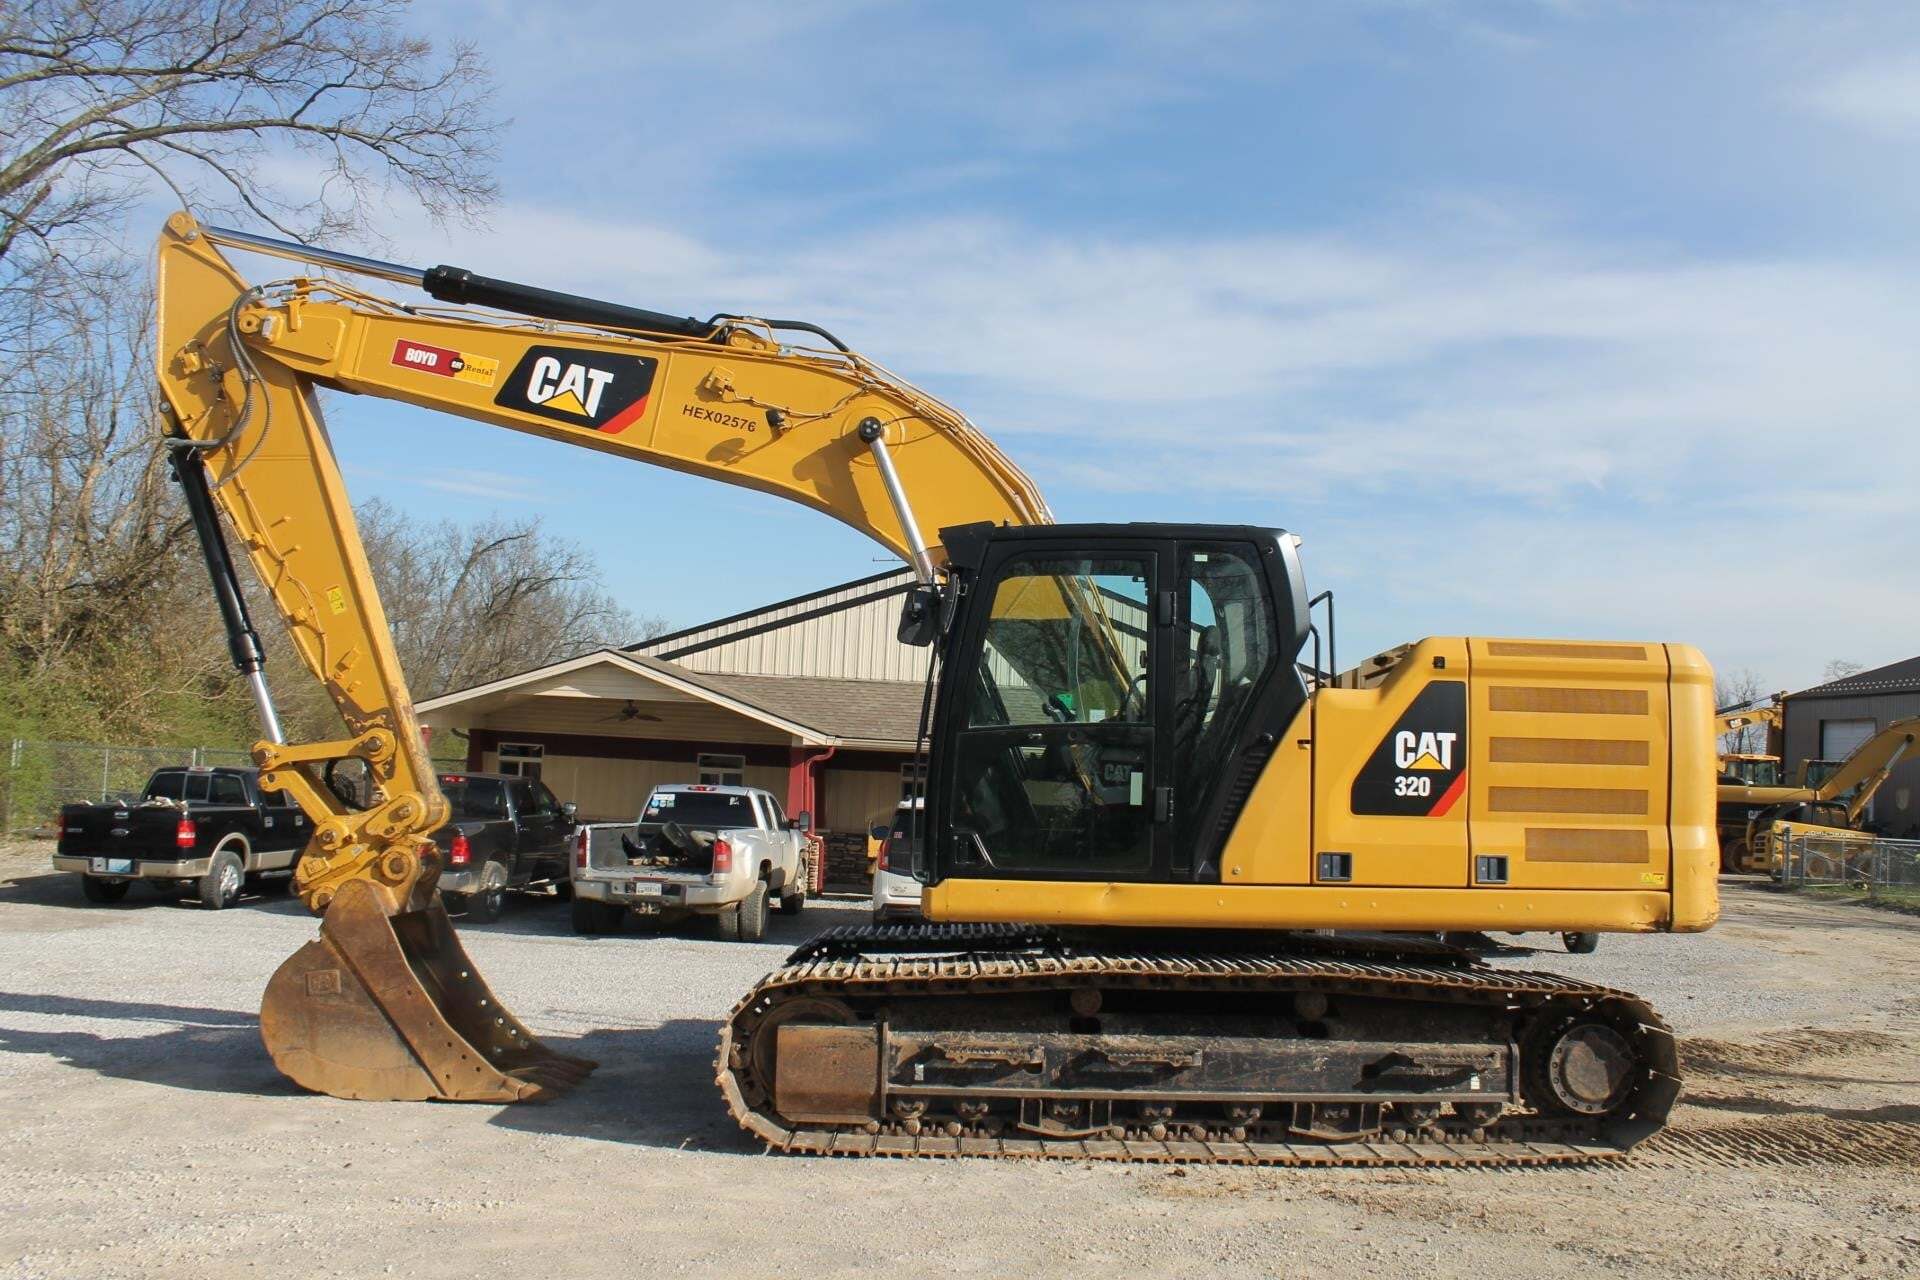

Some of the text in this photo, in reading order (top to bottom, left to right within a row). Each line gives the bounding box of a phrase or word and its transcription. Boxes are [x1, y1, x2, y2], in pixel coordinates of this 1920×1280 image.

[405, 348, 438, 367] BOYD
[466, 364, 494, 377] Rental
[527, 356, 615, 419] CAT
[682, 404, 757, 432] HEX02576
[1395, 730, 1457, 770] CAT
[1394, 775, 1431, 797] 320
